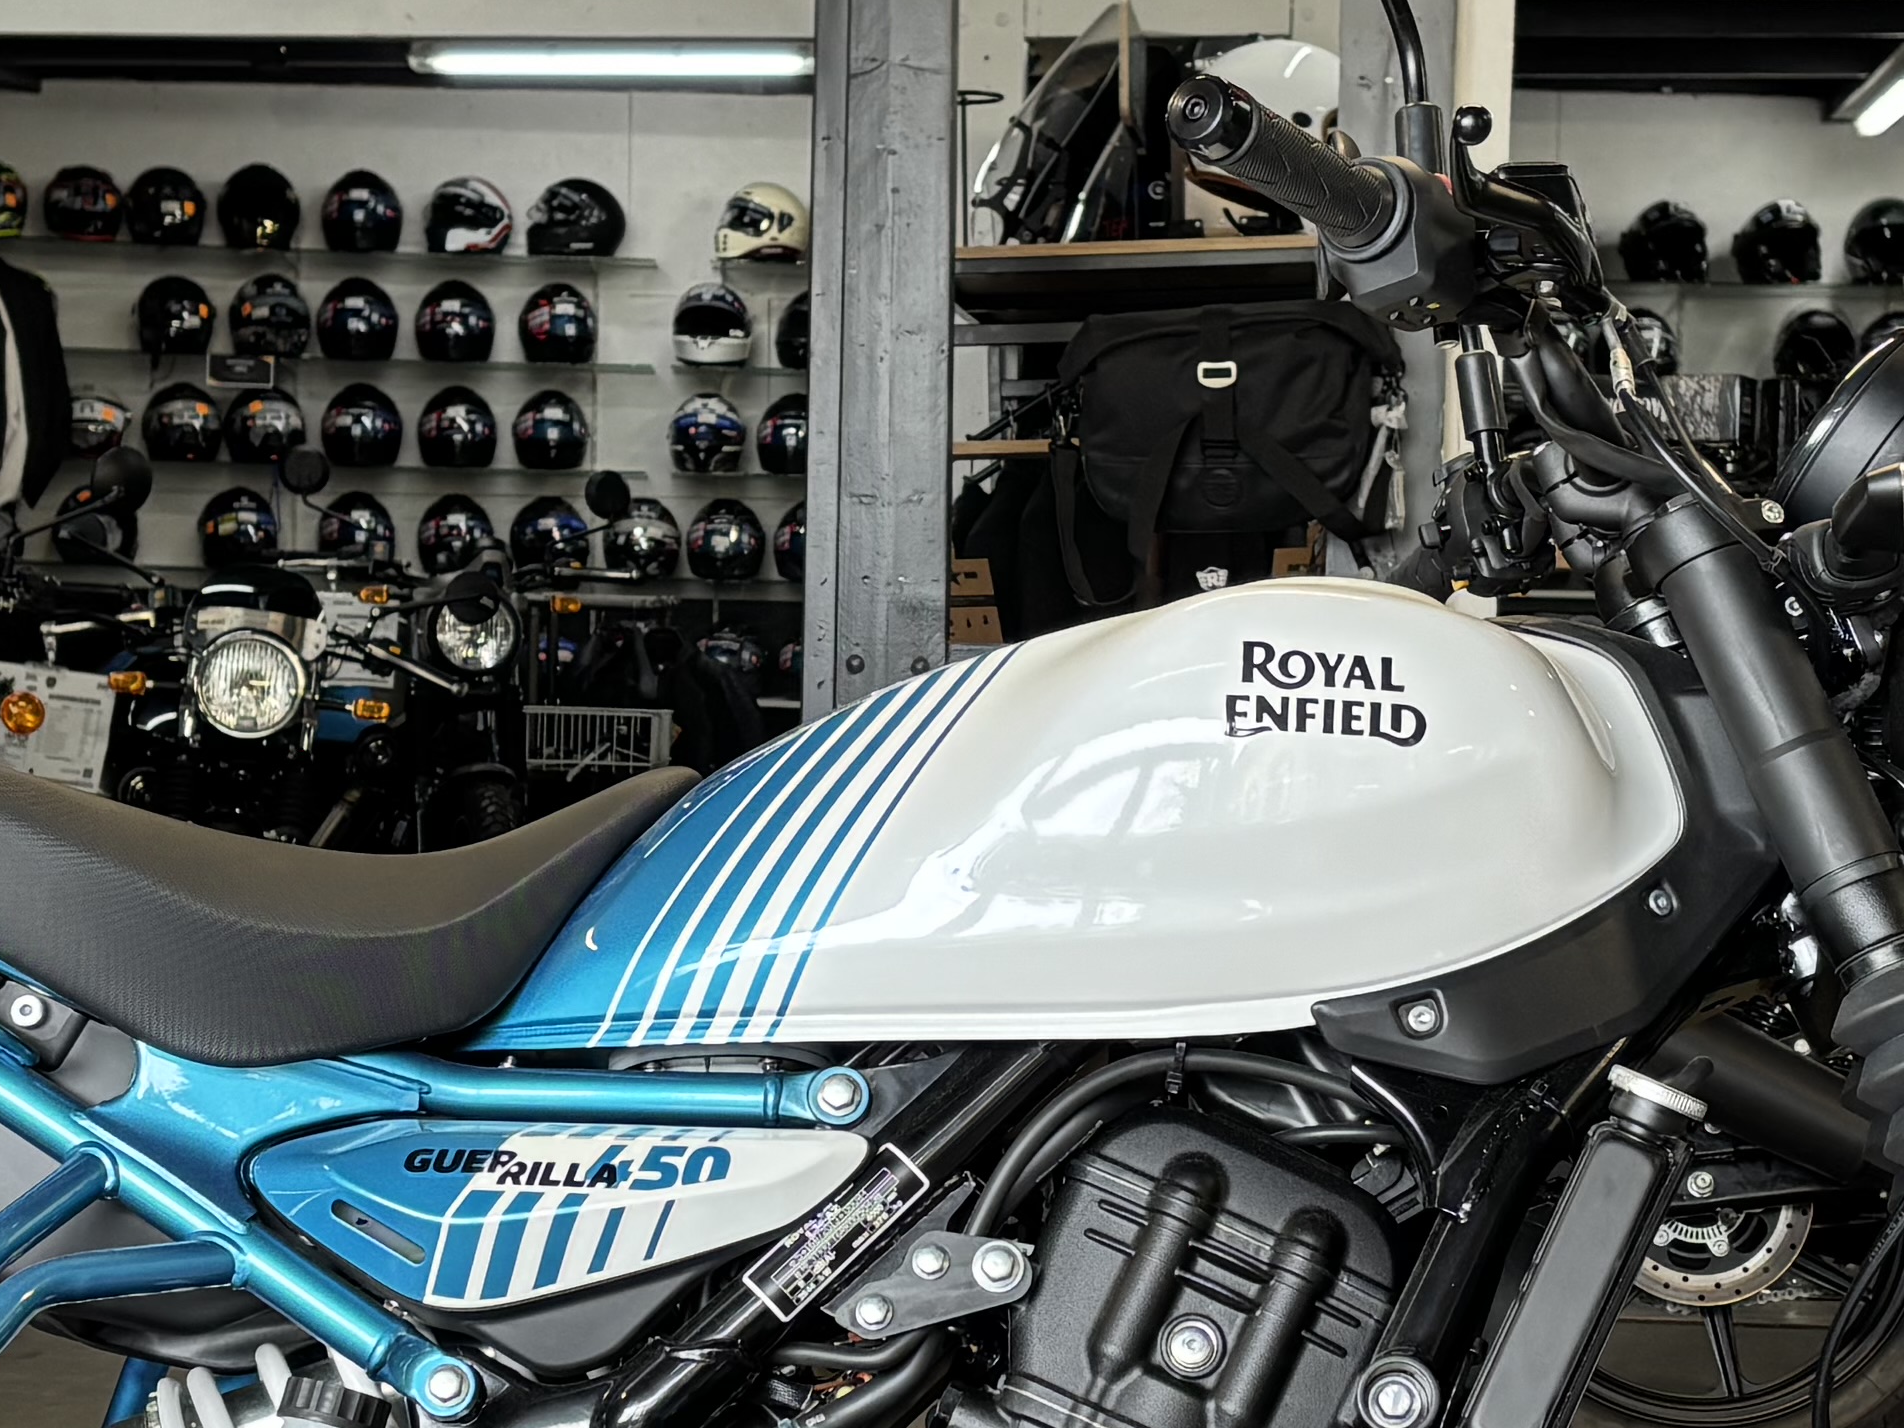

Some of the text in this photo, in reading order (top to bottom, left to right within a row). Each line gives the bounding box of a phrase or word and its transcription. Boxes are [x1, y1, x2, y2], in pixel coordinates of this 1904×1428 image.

[1242, 640, 1405, 692] ROYAL
[1224, 694, 1427, 747] ENFIELD
[585, 1145, 732, 1190] 450
